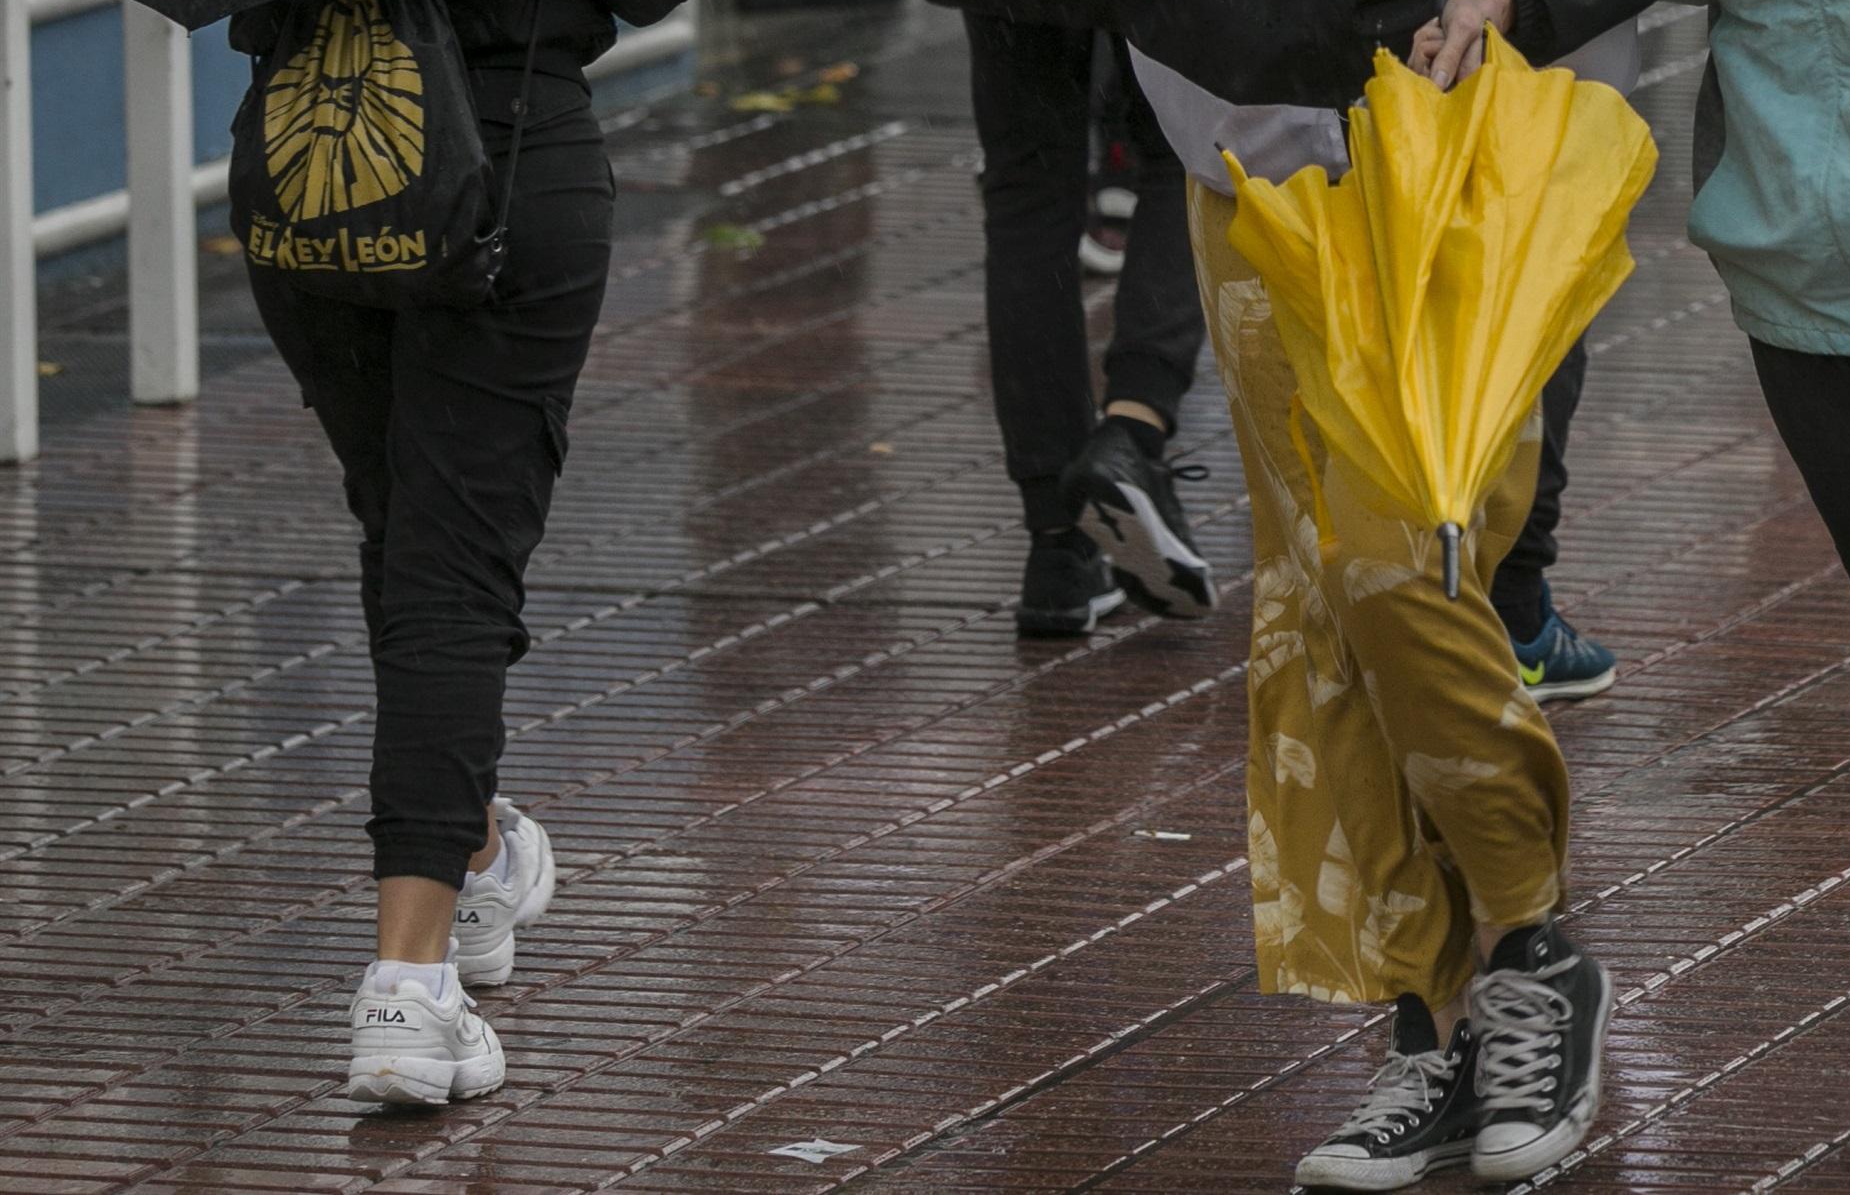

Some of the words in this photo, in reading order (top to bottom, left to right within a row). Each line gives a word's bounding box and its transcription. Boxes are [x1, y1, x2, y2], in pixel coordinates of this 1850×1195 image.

[249, 224, 276, 259] EL
[276, 225, 336, 270] REY
[338, 225, 427, 271] LEÓN
[366, 1008, 406, 1023] FILA
